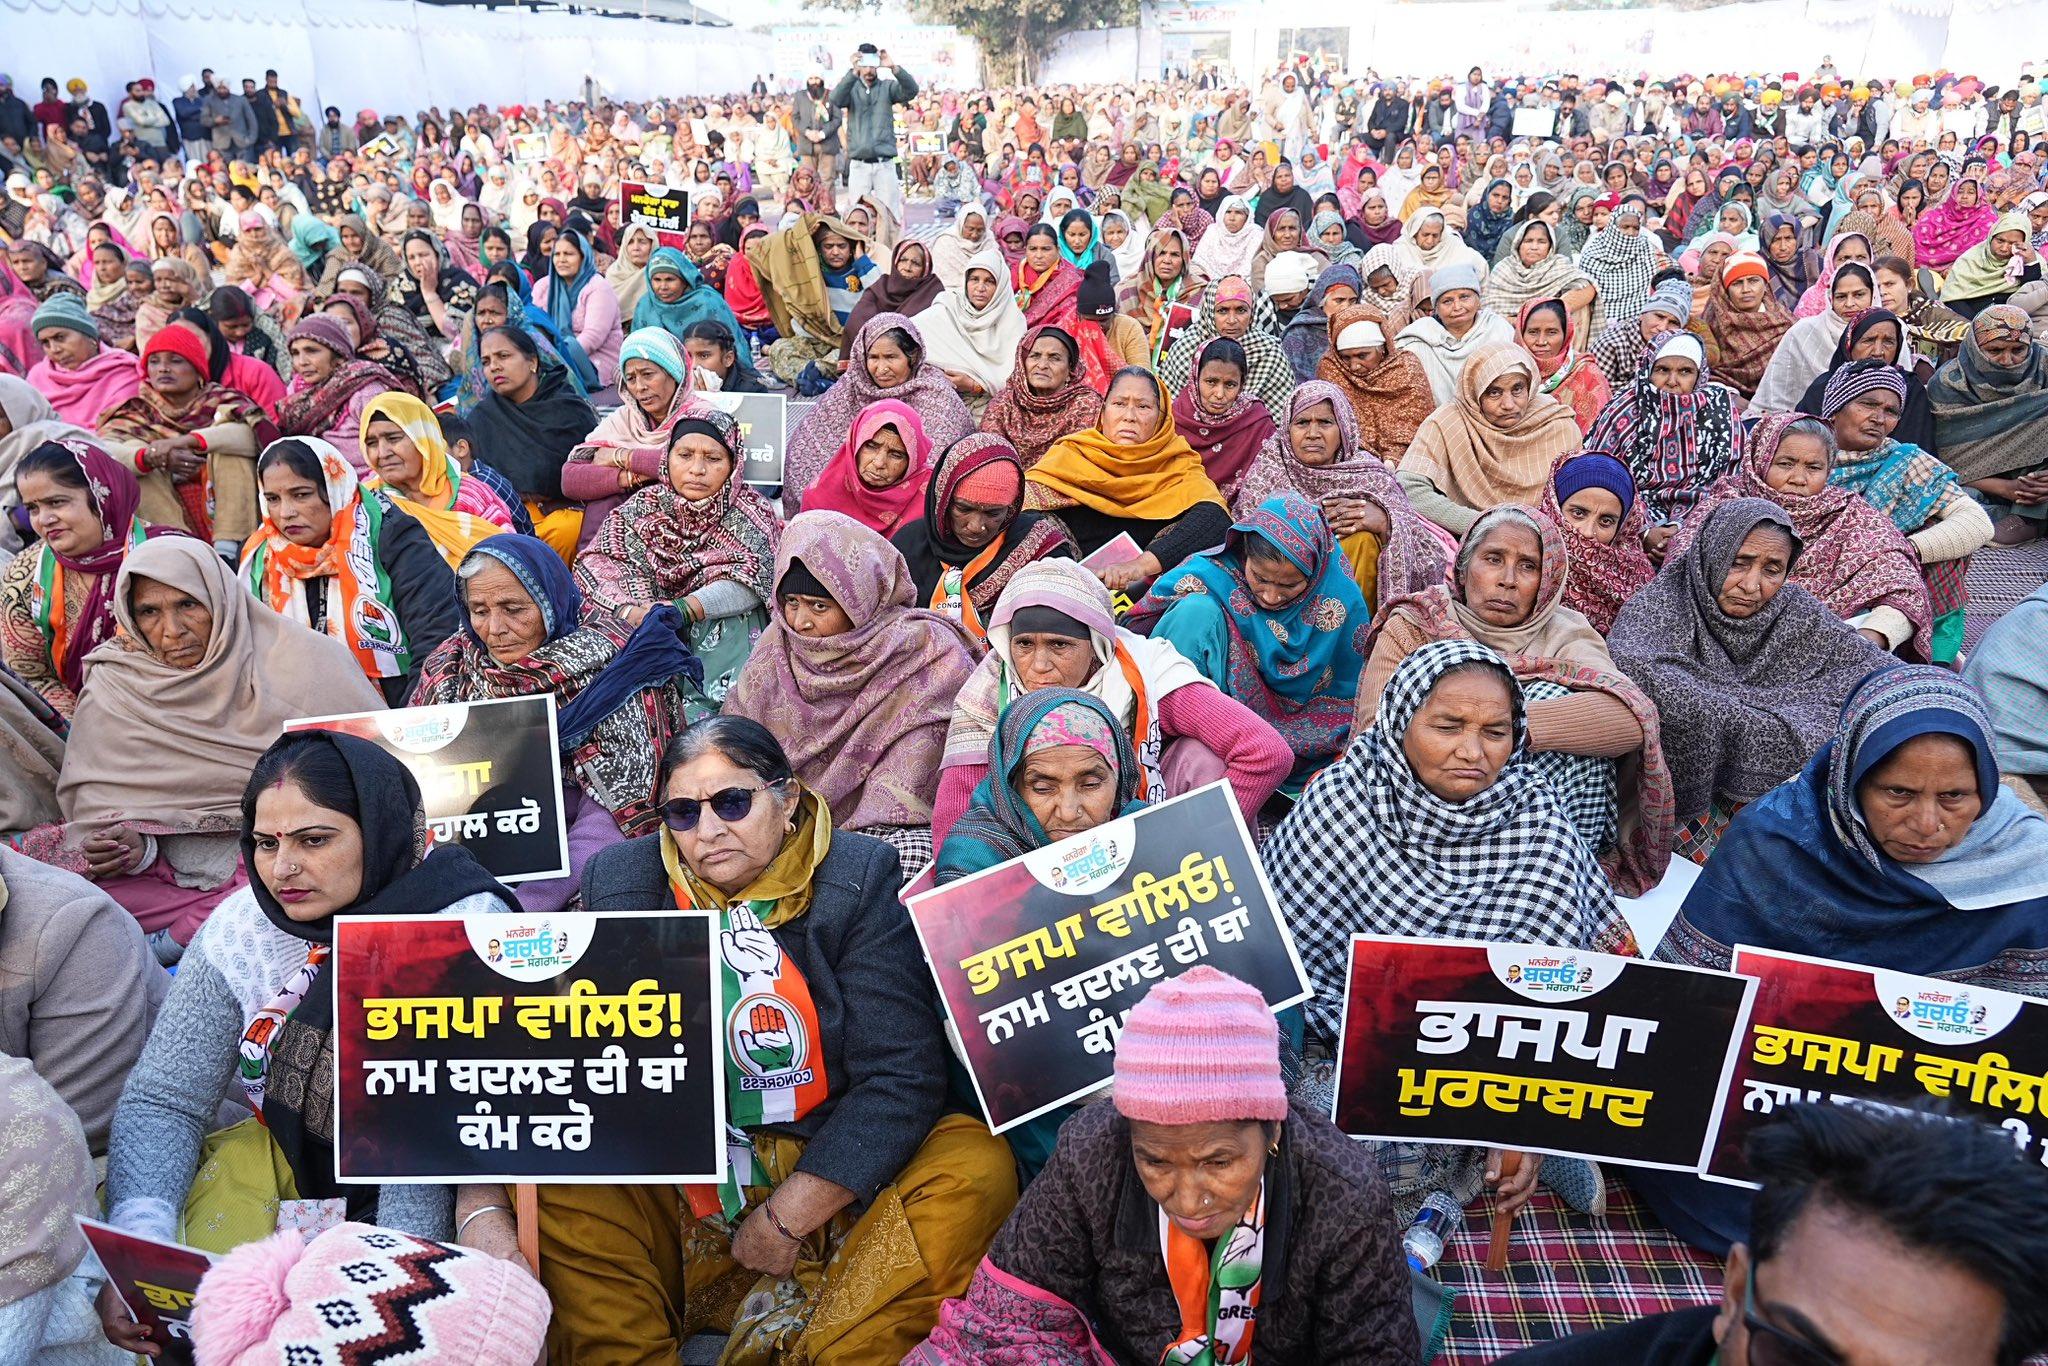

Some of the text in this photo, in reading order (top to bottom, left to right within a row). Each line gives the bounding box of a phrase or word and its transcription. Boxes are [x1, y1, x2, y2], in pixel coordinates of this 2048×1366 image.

[750, 443, 774, 462] ਕਰੋ
[426, 797, 541, 843] ਹਾਲ ਕਰੋ
[1064, 843, 1107, 879] ਬਚਾਓ
[506, 926, 536, 939] ਮਨਰੇਗਾ
[959, 852, 1235, 995] ਭਾਜਪਾ ਵਾਲਿਓ!
[503, 931, 553, 958] ਬਚਾਓ
[528, 954, 560, 967] ਸੰਗਰਾਮ
[978, 896, 1251, 1045] ਨਾਮ ਬਦਲਣ ਦੀ ਥਾਂ
[1523, 963, 1576, 983] ਬਚਾਓ
[1528, 956, 1560, 967] ਮਨਰੇਗਾ
[1546, 981, 1580, 992] ਸੰਗਰਾਮ
[1918, 991, 1952, 1003] ਮਨਰੇਗਾ
[363, 979, 682, 1040] ਭਾਜਪਾ ਵਾਲਿਓ!
[1912, 1001, 1969, 1024] ਬਚਾਓ
[1415, 1000, 1660, 1069] ਭਾਜਪਾ
[1936, 1019, 1974, 1035] ਸੰਗਰਾਮ
[363, 1043, 688, 1095] ਨਾਮ ਬਦਲਣ ਦੀ ਥਾਂ
[1753, 1024, 1904, 1083] ਭਾਜਪਾ
[1914, 1052, 2048, 1120] ਵਾਲਿ
[1398, 1069, 1654, 1127] ਮੁਰਦਾਬਾਦ
[457, 1099, 594, 1151] ਕੰਮ ਕਰੋ
